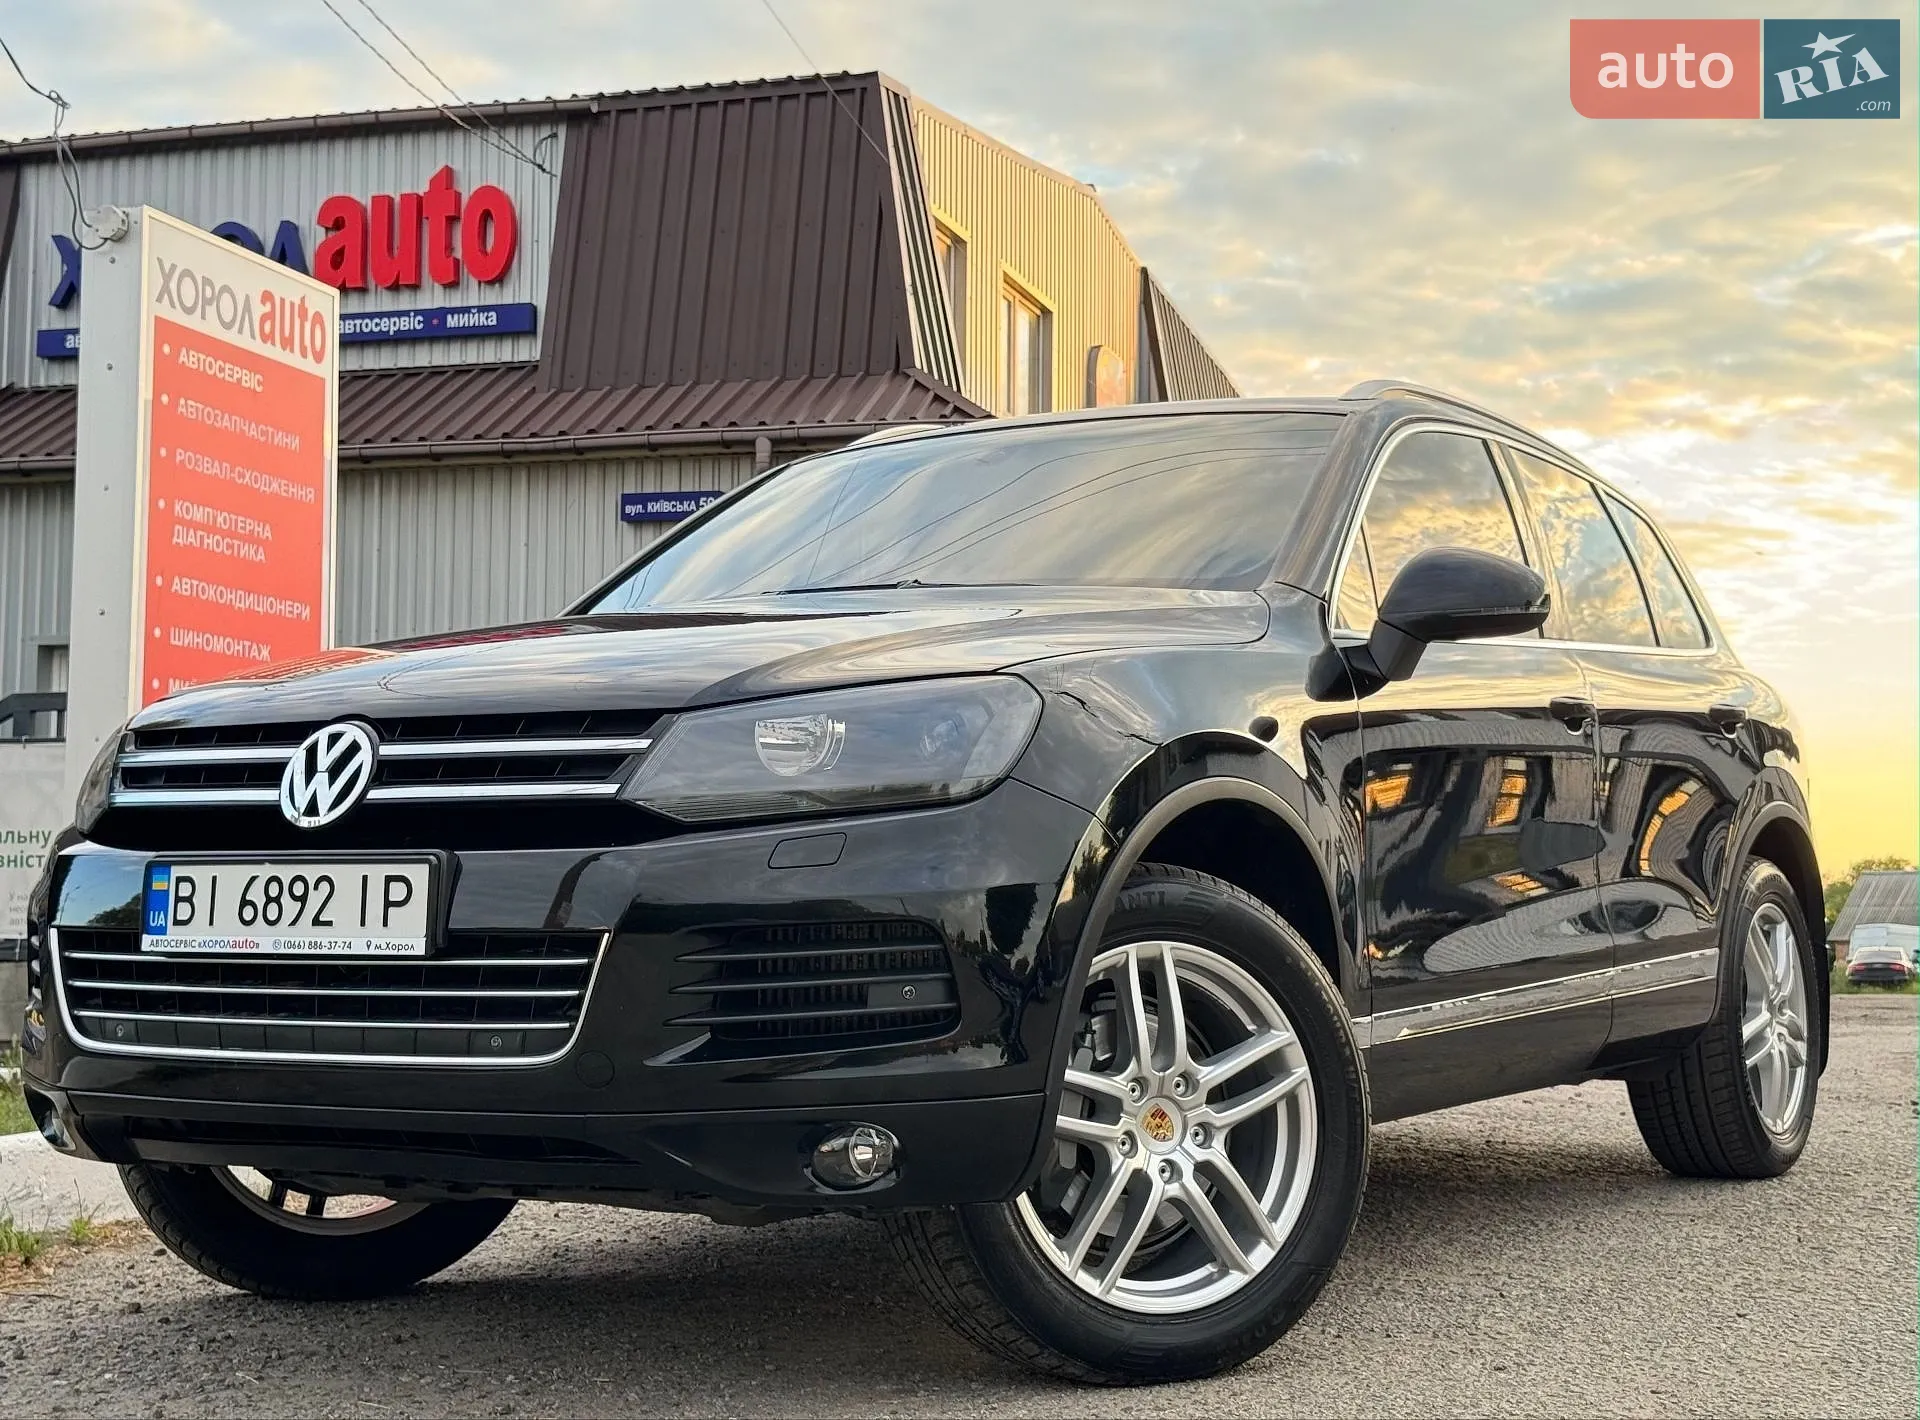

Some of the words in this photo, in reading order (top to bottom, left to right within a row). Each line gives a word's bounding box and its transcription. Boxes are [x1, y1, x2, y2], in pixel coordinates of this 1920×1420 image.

[446, 308, 497, 329] мийка
[178, 346, 265, 393] АВТОСЕРВІС
[177, 397, 301, 453] АВТОЗАПЧАСТИНИ
[175, 447, 316, 504] РОЗВАЛ-СХОДЖЕННЯ
[174, 499, 273, 541] КОМП'ЮТЕРНА
[625, 504, 645, 516] вул.
[647, 499, 697, 513] КИЇВСЬКА
[172, 524, 267, 563] ДІАГНОСТИКА
[171, 575, 311, 621] АВТОКОНДИЦІОНЕРИ
[169, 626, 272, 662] ШИНОМОНТАЖ
[149, 910, 166, 927] UA
[237, 874, 336, 927] 6892
[149, 939, 197, 949] АВТОСЕРВІС
[283, 940, 306, 951] (066)
[307, 940, 353, 951] 886-37-74
